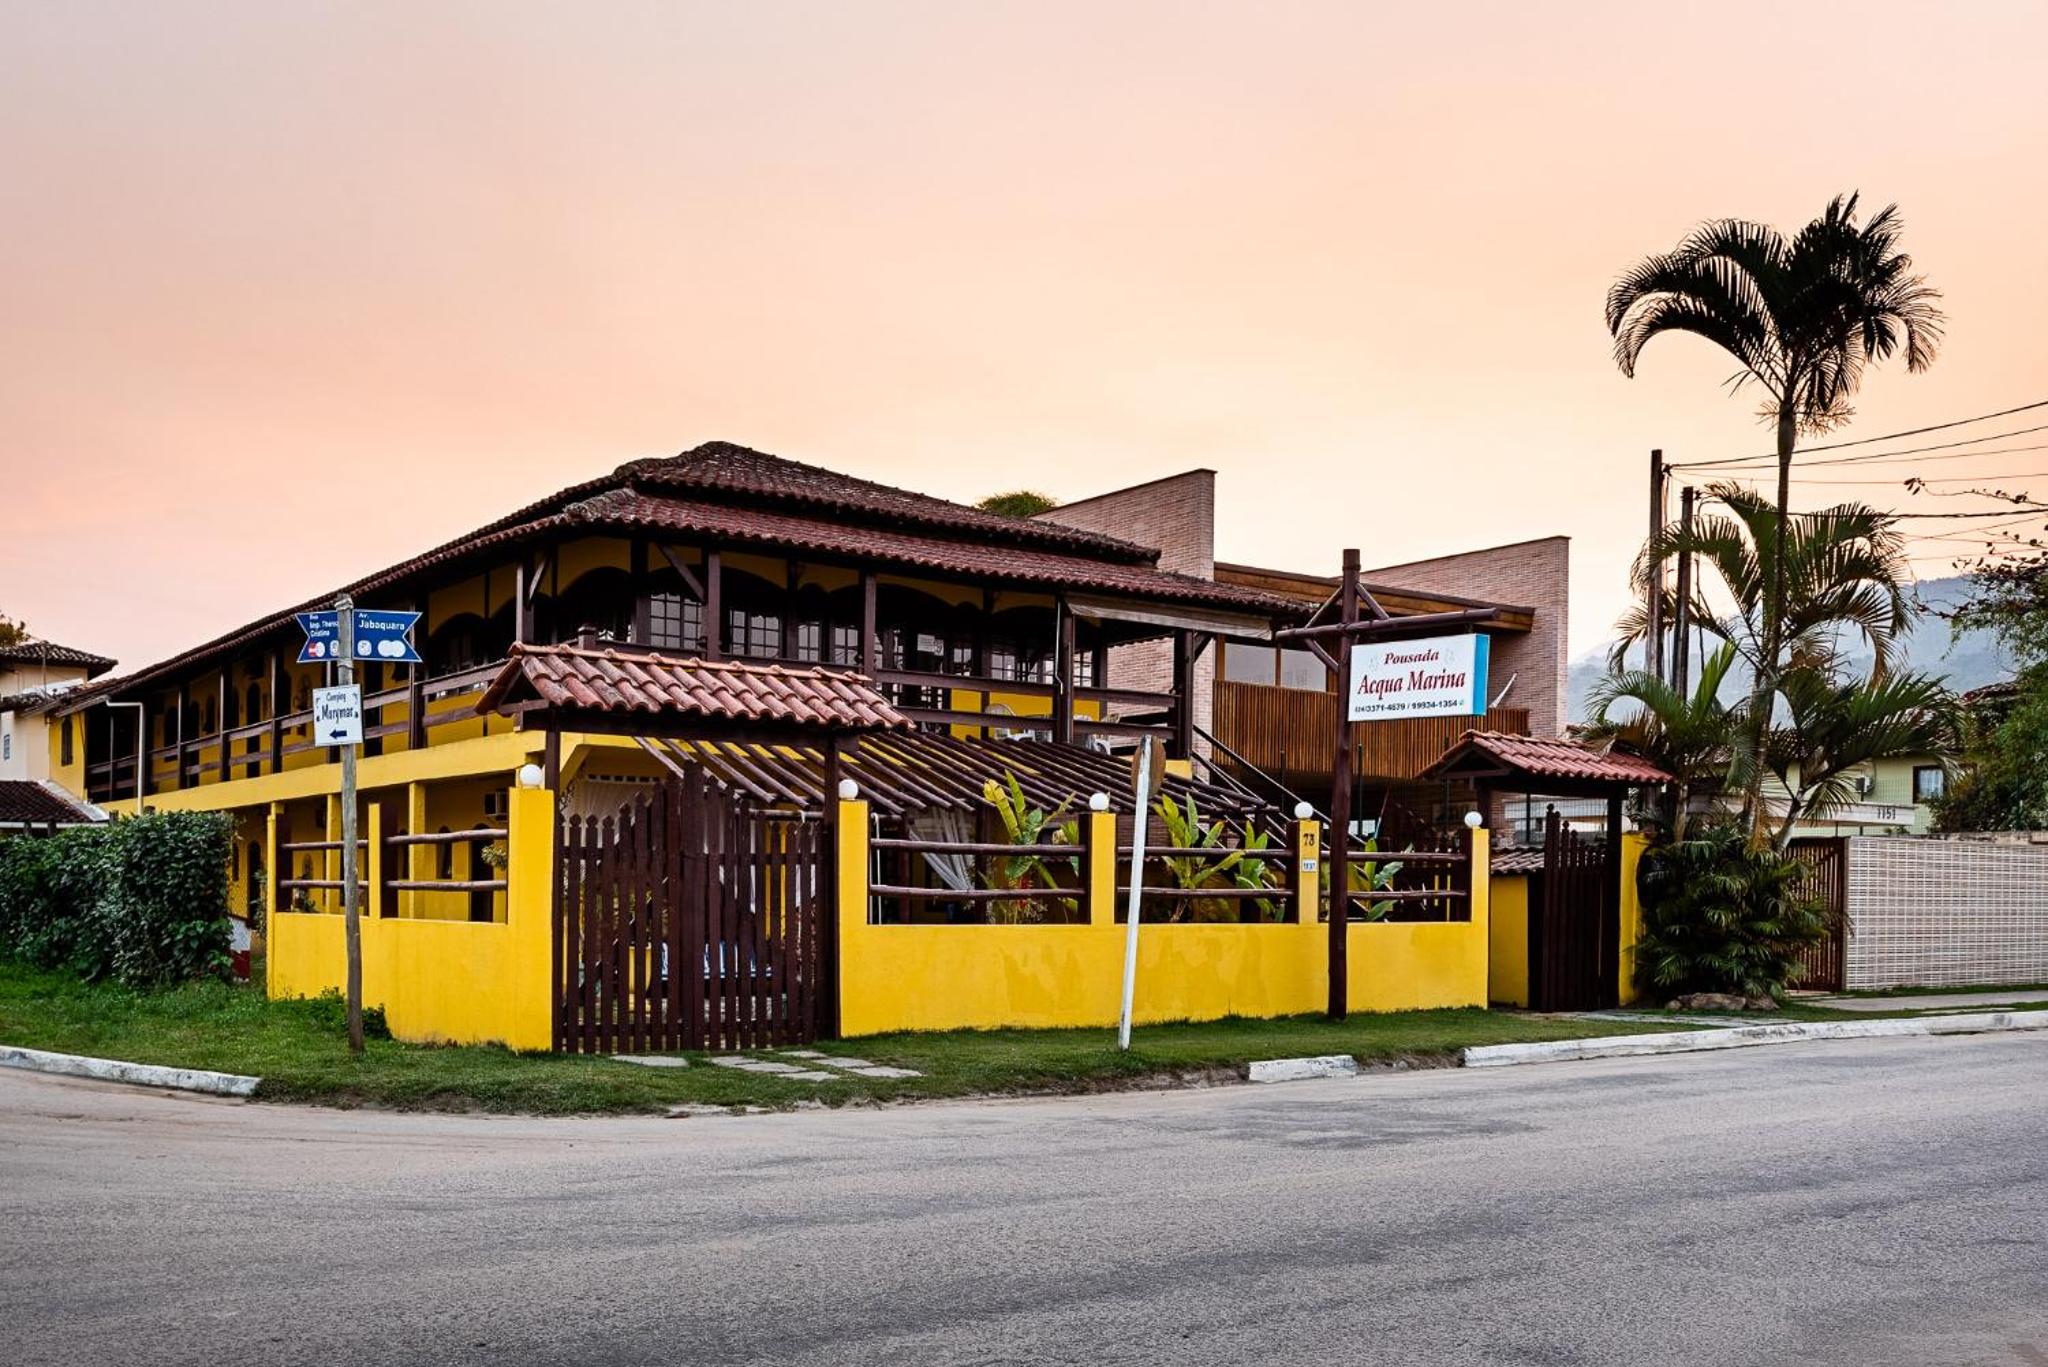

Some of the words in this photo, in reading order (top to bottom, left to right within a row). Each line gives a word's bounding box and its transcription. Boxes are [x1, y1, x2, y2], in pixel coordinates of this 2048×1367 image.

[358, 619, 405, 631] Jabaquara
[1384, 648, 1440, 665] Pousada
[1357, 673, 1403, 701] Acqua
[1407, 668, 1466, 692] Marina
[1877, 807, 1896, 820] 1151
